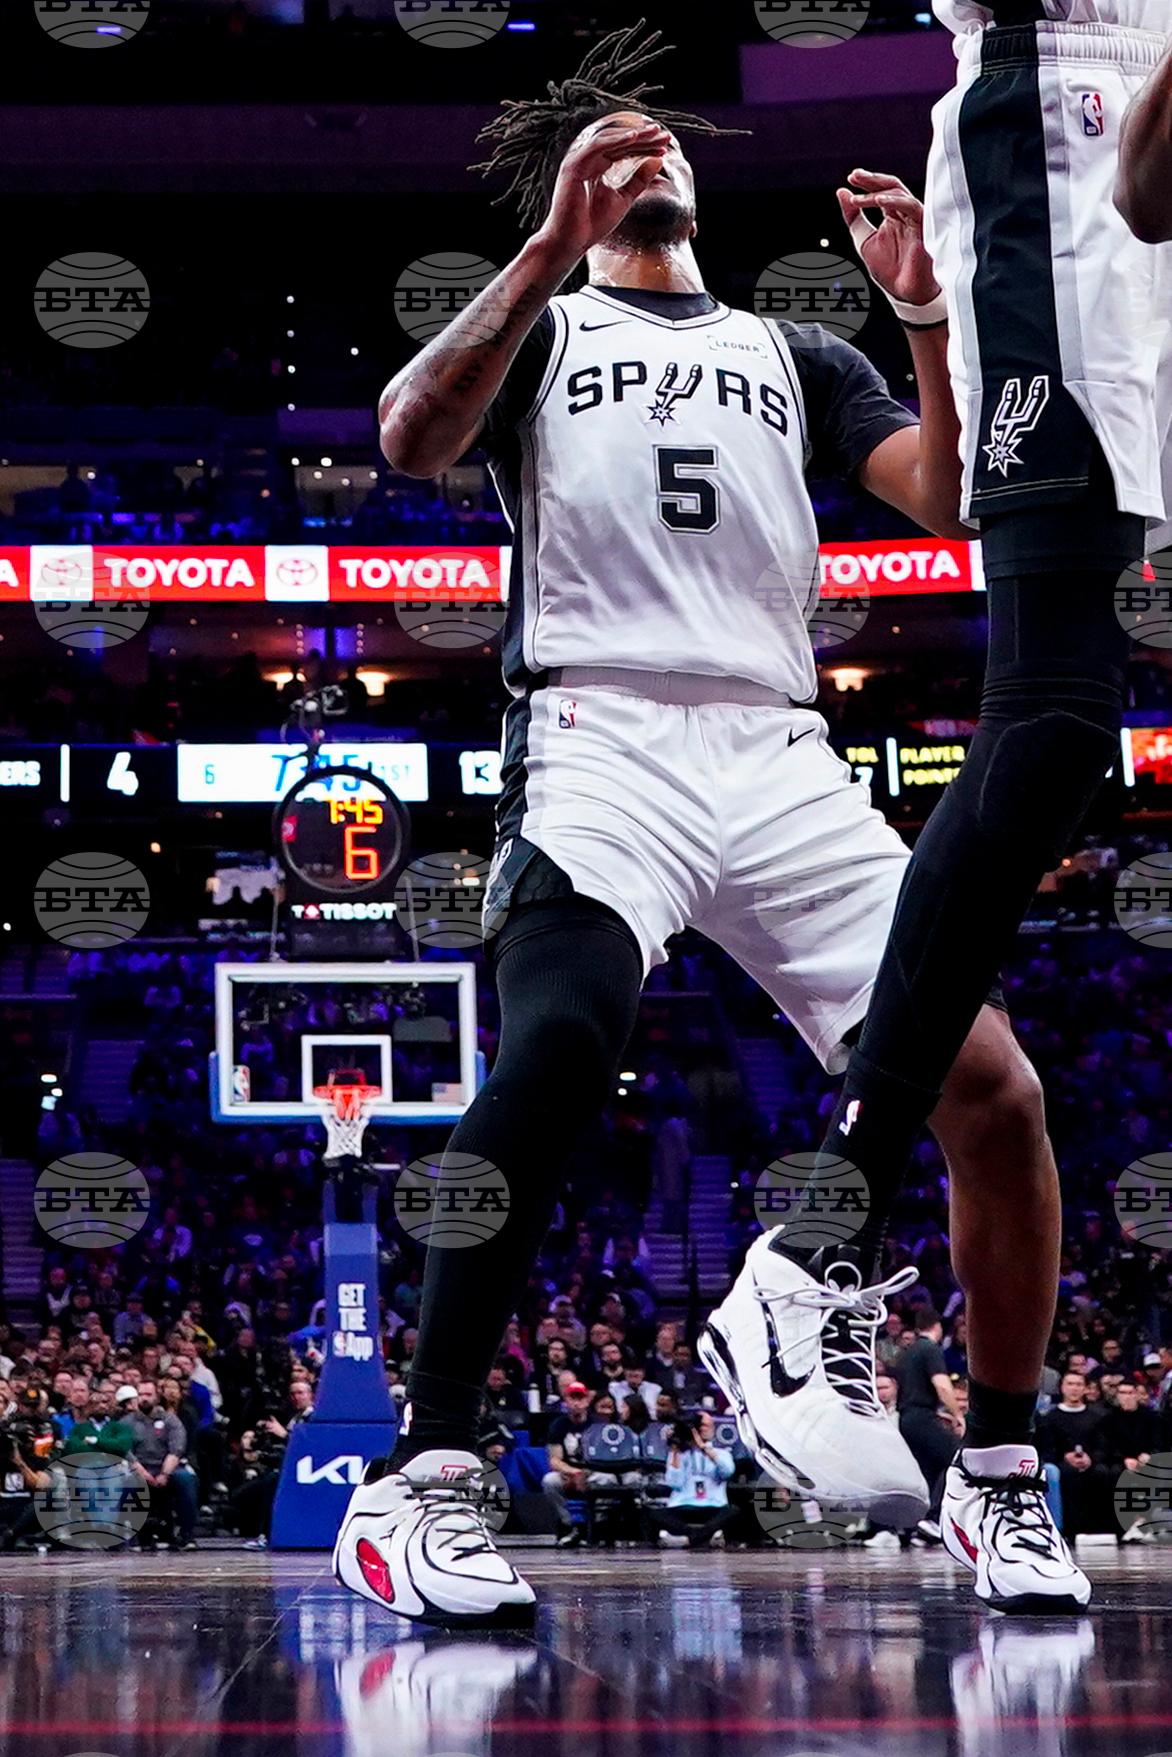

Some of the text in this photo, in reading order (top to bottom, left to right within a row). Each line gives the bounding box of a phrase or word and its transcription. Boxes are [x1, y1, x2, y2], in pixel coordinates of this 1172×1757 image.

[715, 340, 760, 354] LEDGER
[567, 360, 789, 438] SPURS
[652, 444, 722, 536] 5
[103, 557, 256, 588] TOYOTA
[339, 557, 491, 588] TOYOTA
[820, 549, 961, 585] TOYOTA
[845, 746, 879, 763] TOL
[900, 745, 966, 764] PLAYER
[106, 751, 140, 796] 4
[203, 764, 216, 786] 6
[459, 750, 502, 795] 13
[343, 824, 379, 880] 6
[319, 903, 397, 920] TISSOT
[337, 1282, 367, 1307] GET
[338, 1307, 368, 1332] THE
